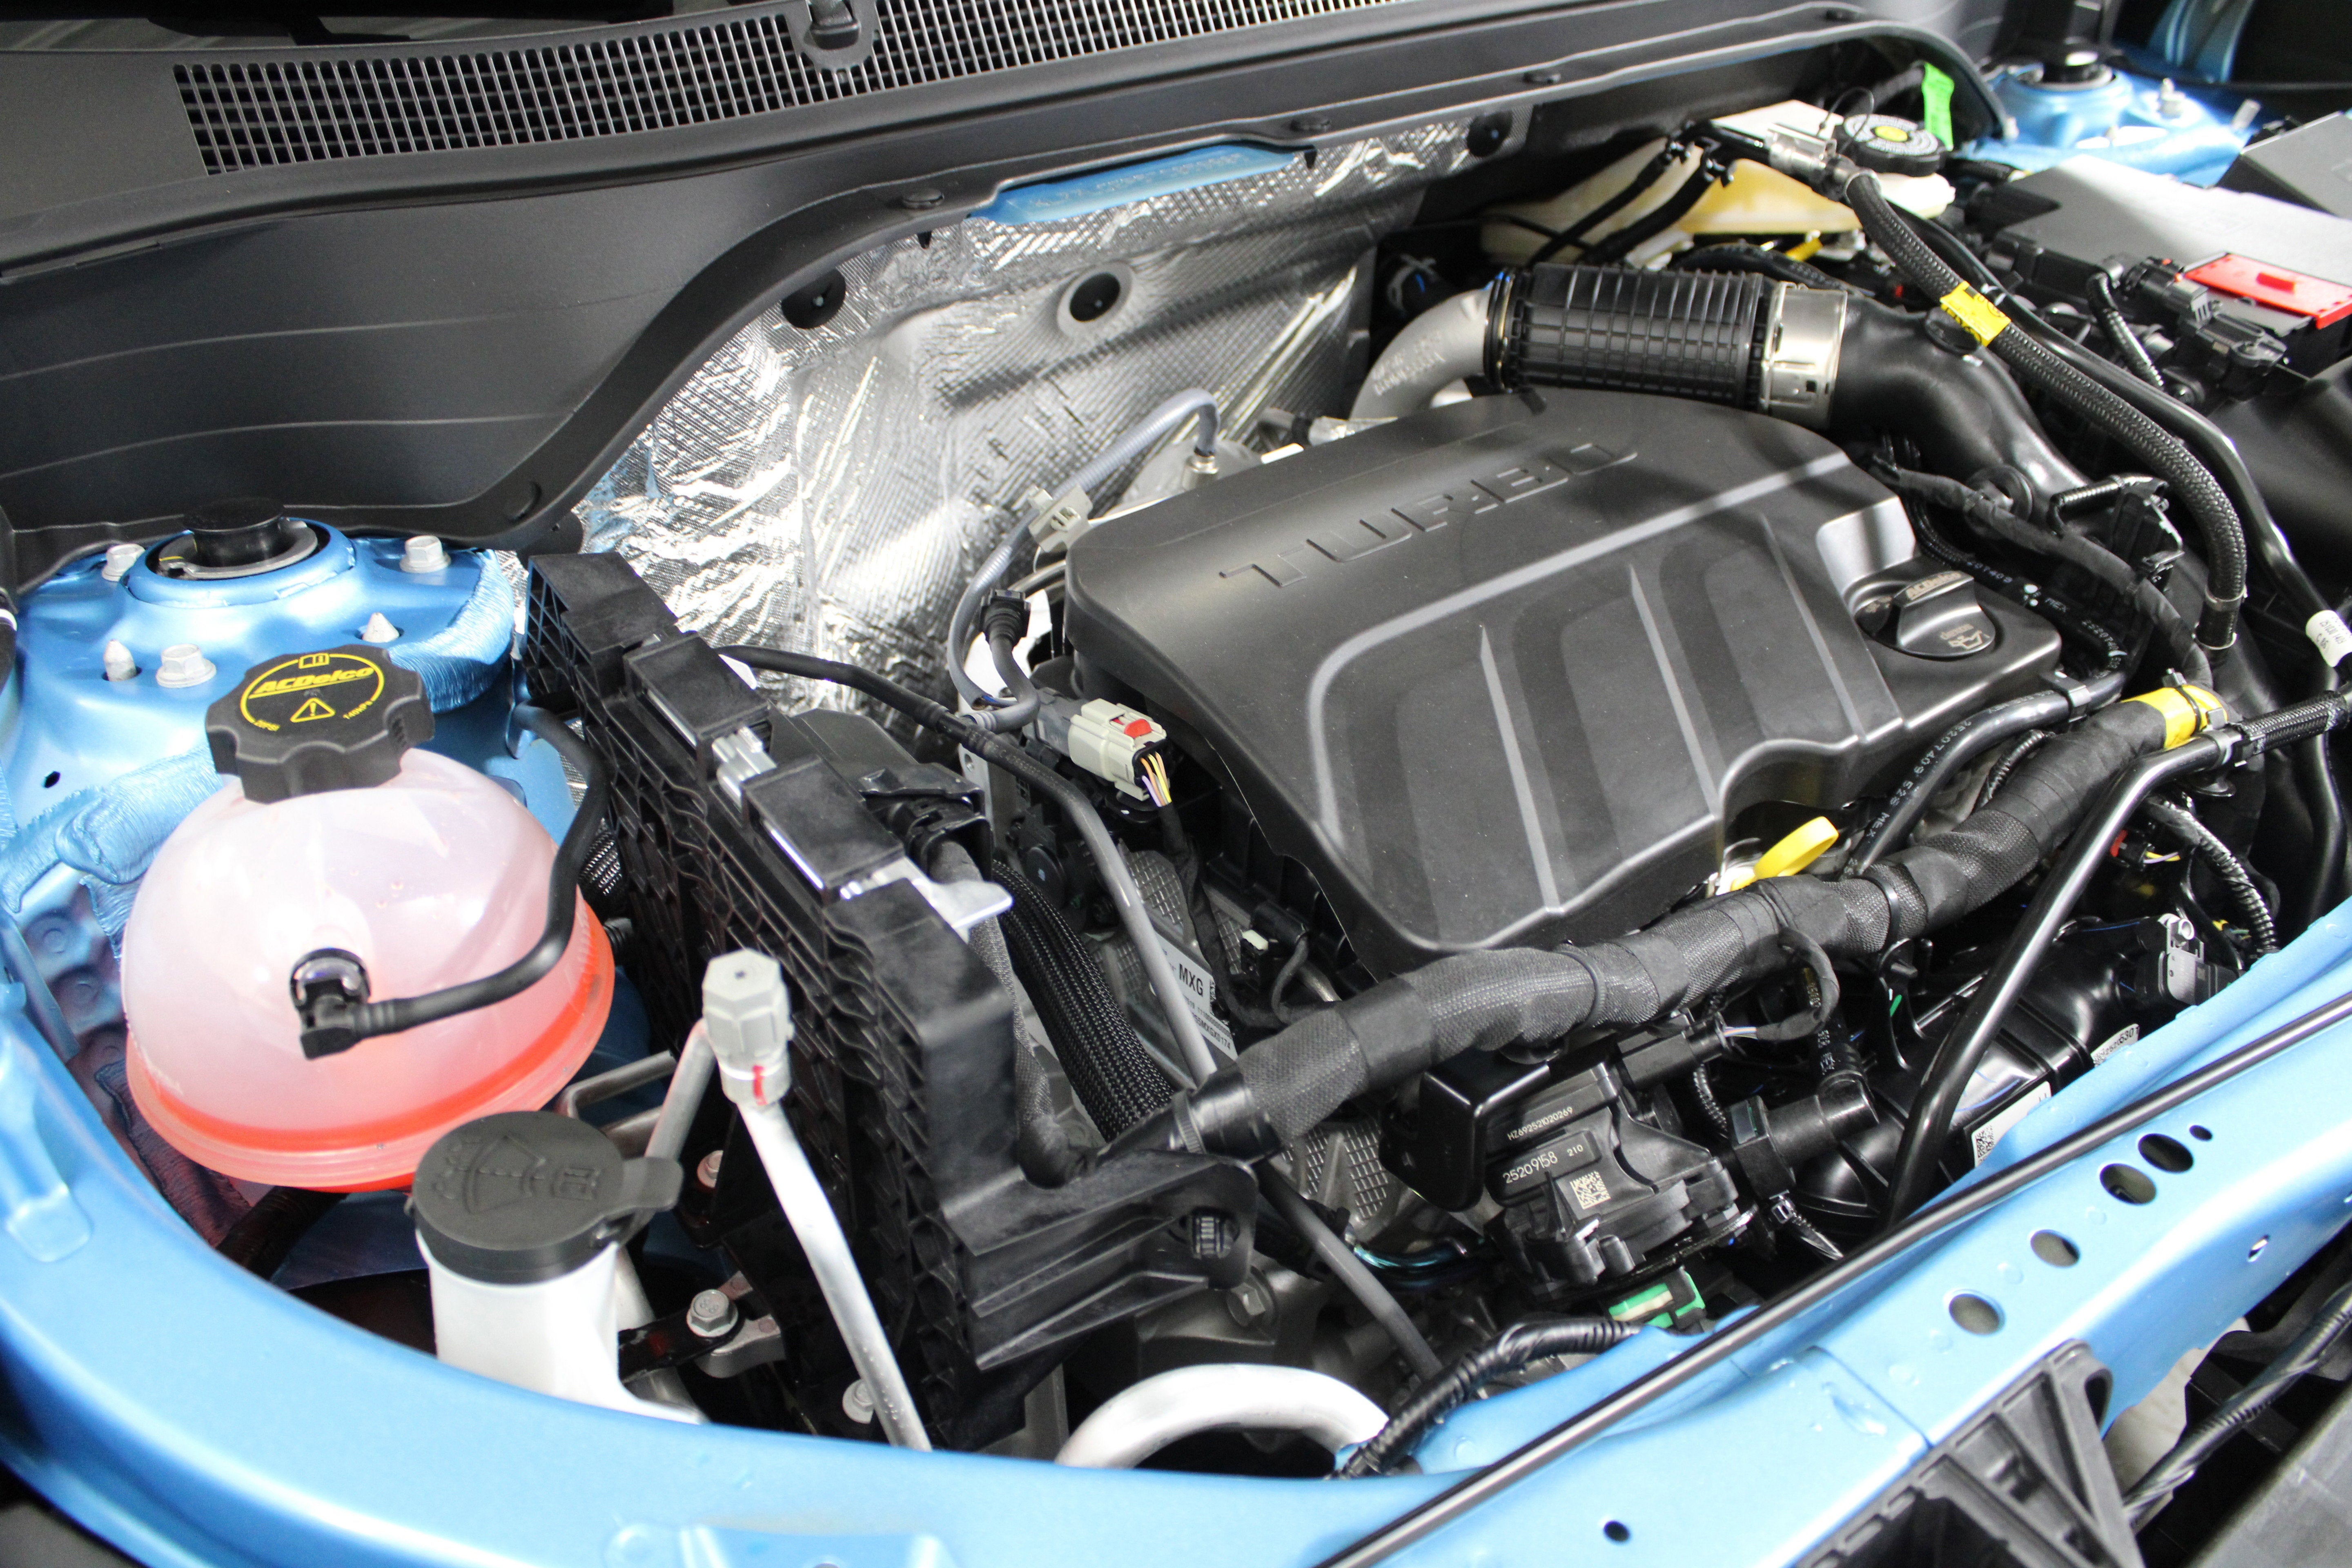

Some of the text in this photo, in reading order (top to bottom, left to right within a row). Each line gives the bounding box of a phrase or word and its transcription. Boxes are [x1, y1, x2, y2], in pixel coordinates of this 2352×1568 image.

[1218, 442, 1637, 588] TURBO
[1905, 572, 1962, 600] ACDelco
[252, 667, 374, 695] ACDelco
[1867, 812, 1890, 837] MEX
[1179, 963, 1204, 998] MXG
[1507, 1106, 1573, 1141] HZ692521020269
[1502, 1144, 1584, 1184] 25209158 210
